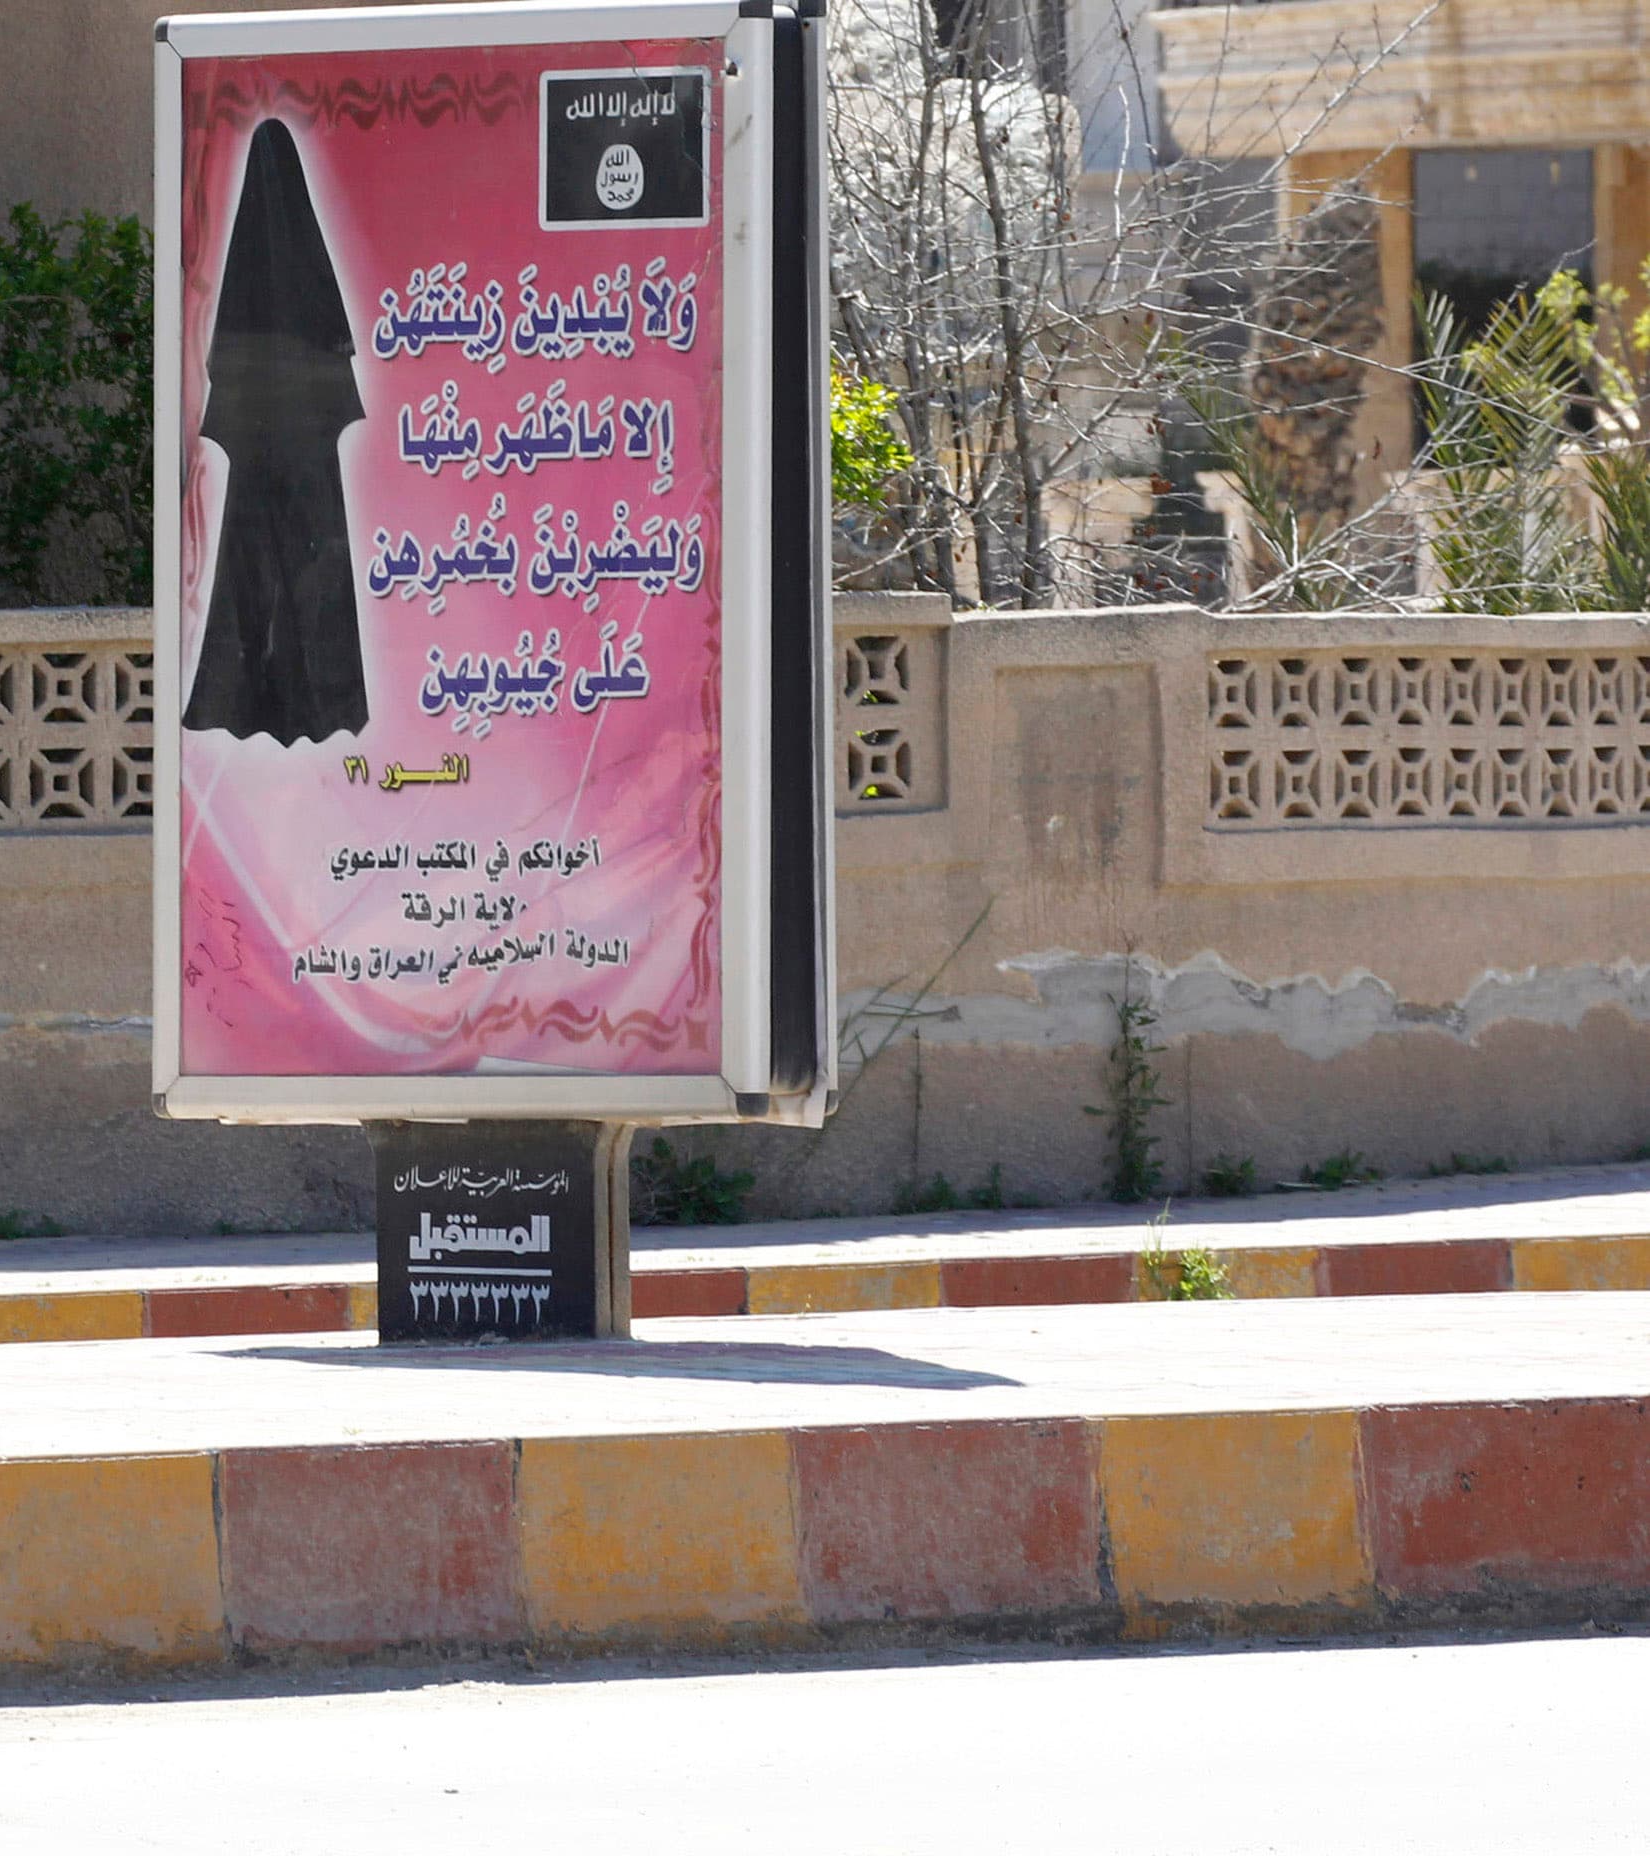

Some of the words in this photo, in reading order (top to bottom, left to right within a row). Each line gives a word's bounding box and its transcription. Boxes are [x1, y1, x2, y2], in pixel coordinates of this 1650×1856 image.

[566, 91, 603, 120] الله
[605, 148, 630, 168] الله
[600, 171, 639, 188] رسول
[607, 187, 635, 203] محمد
[330, 843, 410, 881] الدعوي
[415, 840, 477, 878] المكتب
[485, 840, 510, 882] في
[402, 893, 466, 928] الرقة
[293, 943, 361, 982] والشام
[368, 946, 434, 979] العراق
[565, 929, 630, 967] الدولة
[408, 1212, 550, 1260] المستقبل
[408, 1280, 550, 1324] ٣٣٣٣٣٣٣
